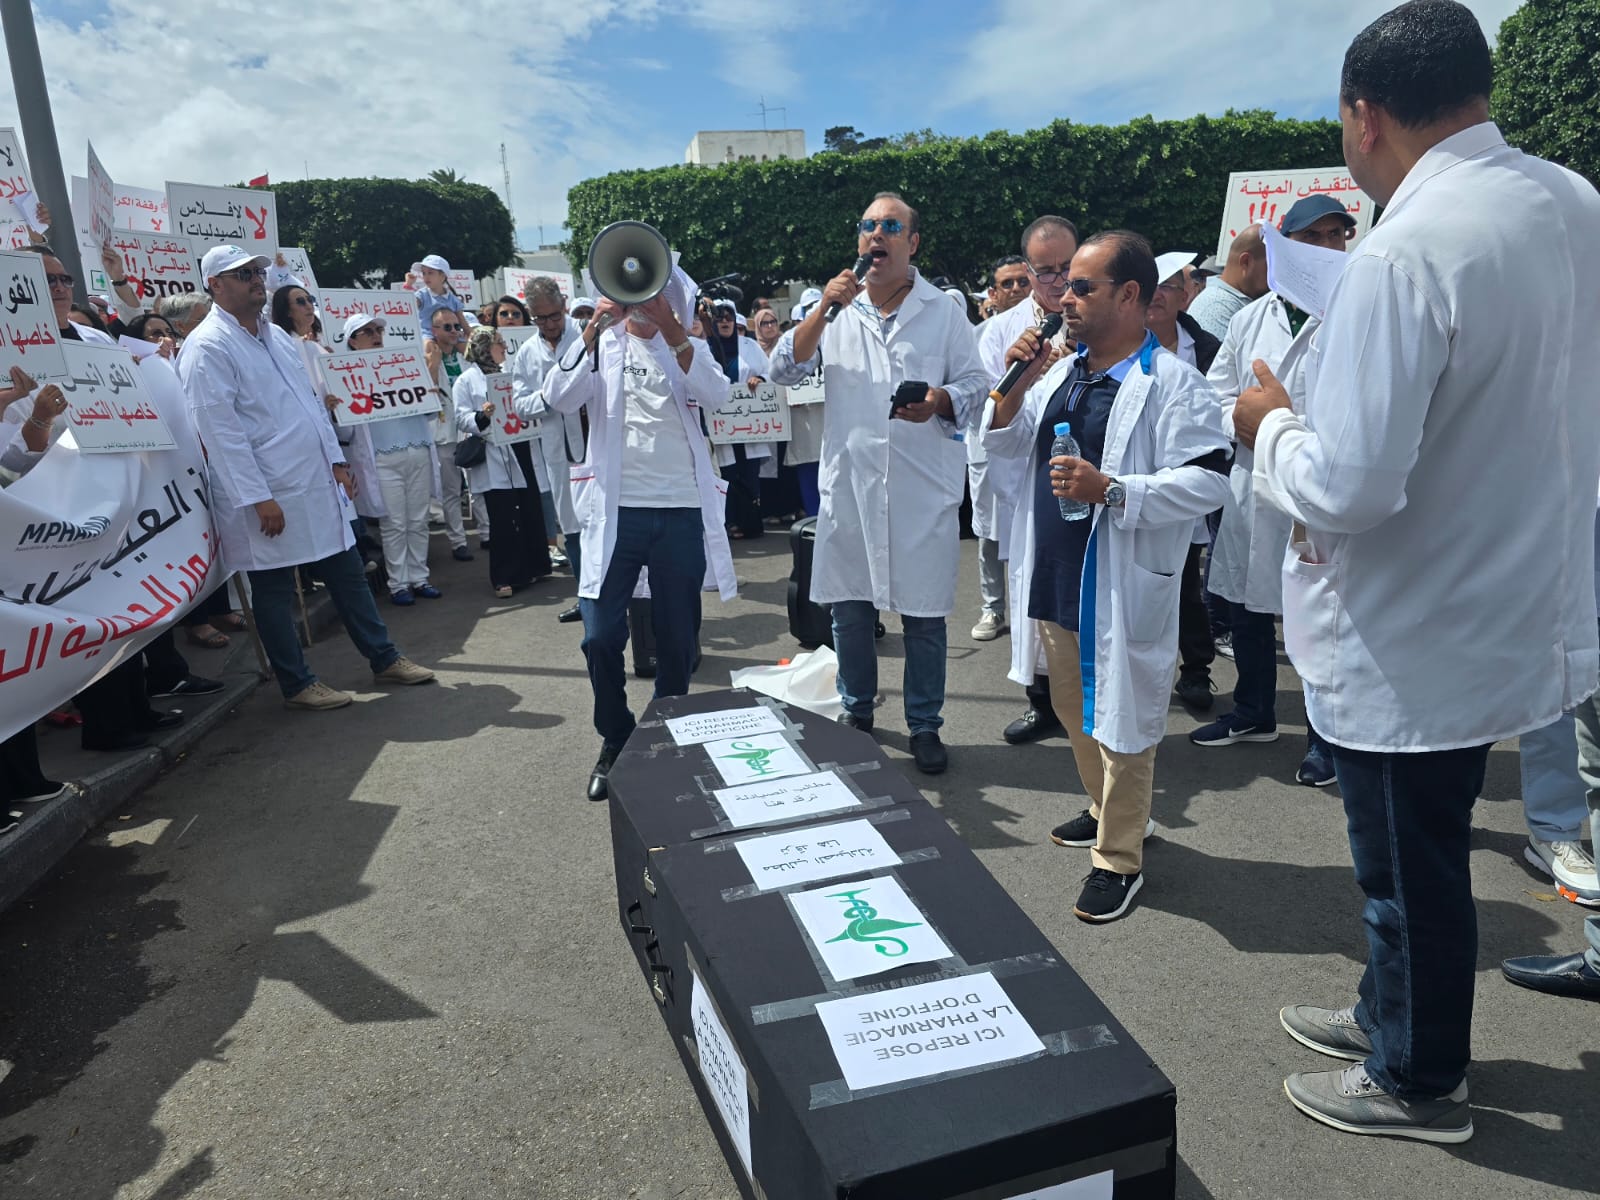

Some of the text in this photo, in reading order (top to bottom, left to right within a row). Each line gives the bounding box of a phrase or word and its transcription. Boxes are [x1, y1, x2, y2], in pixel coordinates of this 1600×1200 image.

[1239, 179, 1293, 199] المهنة
[245, 206, 268, 239] لا
[6, 322, 57, 355] خاصها
[389, 325, 415, 341] يهدد
[327, 353, 416, 373] ماتقيش المهنة
[370, 386, 427, 410] STOP
[113, 402, 159, 428] خاصها
[675, 714, 771, 735] LA PHARMACIE
[684, 712, 755, 727] ICI REPOSE
[691, 722, 763, 737] D'OFFICINE
[857, 992, 982, 1024] D'OFFICINE
[843, 1004, 1014, 1047] LA PHARMACIE
[873, 1025, 1006, 1061] ICI REPOSE
